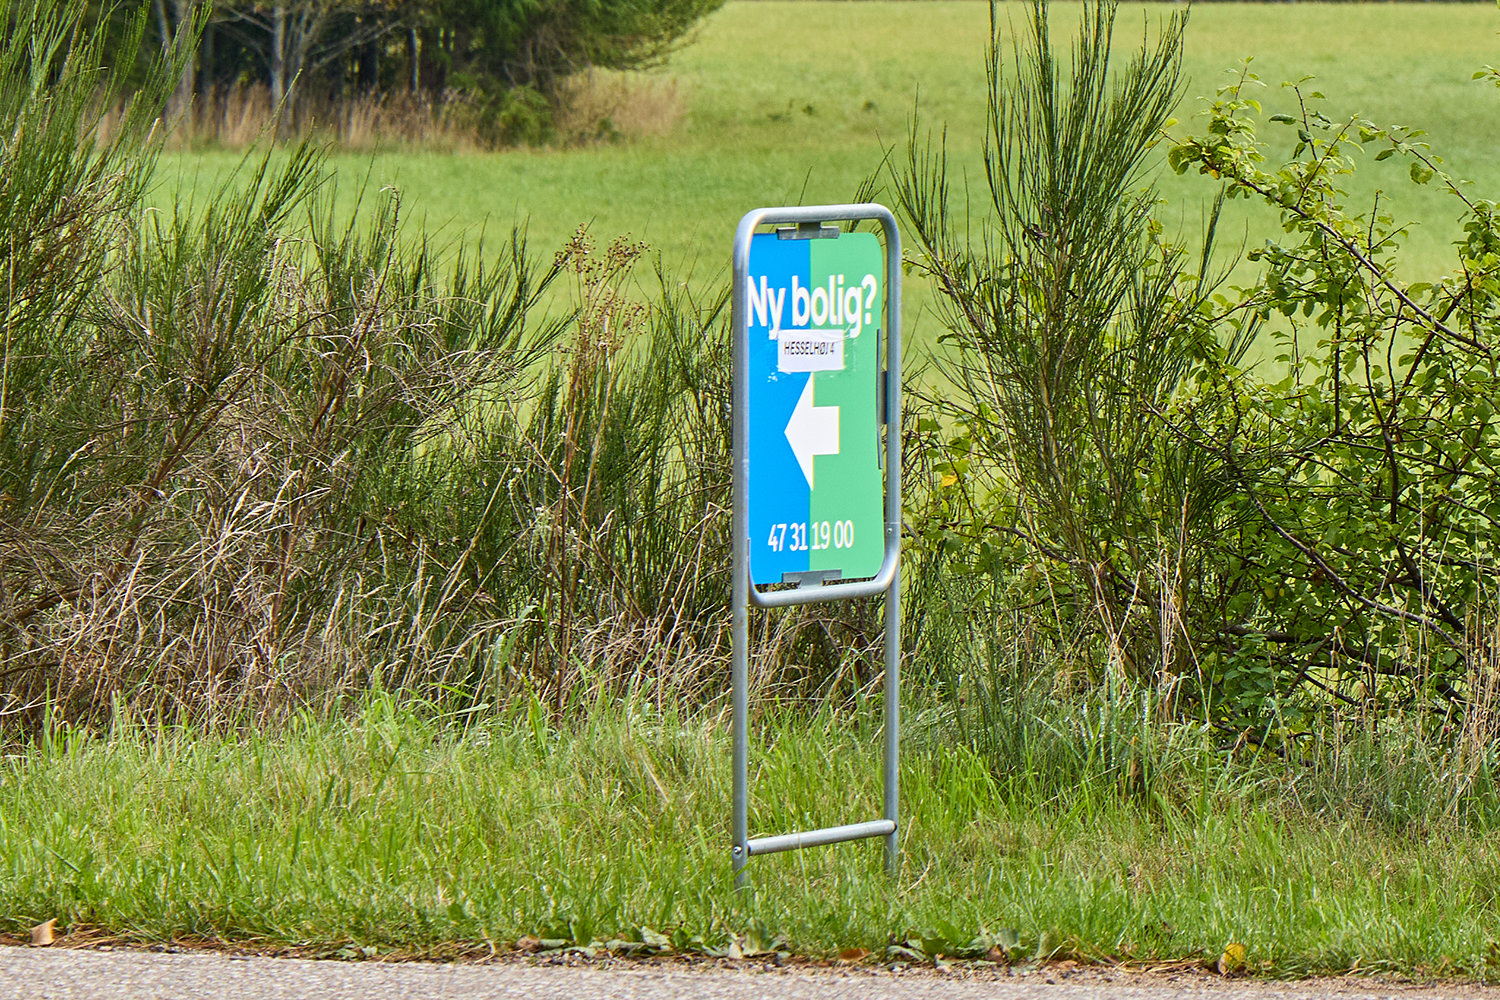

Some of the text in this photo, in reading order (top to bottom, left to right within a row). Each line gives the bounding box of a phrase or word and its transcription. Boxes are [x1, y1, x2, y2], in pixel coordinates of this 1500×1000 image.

[747, 274, 878, 340] Ny bolig?
[768, 520, 854, 552] 47 31 19 00
